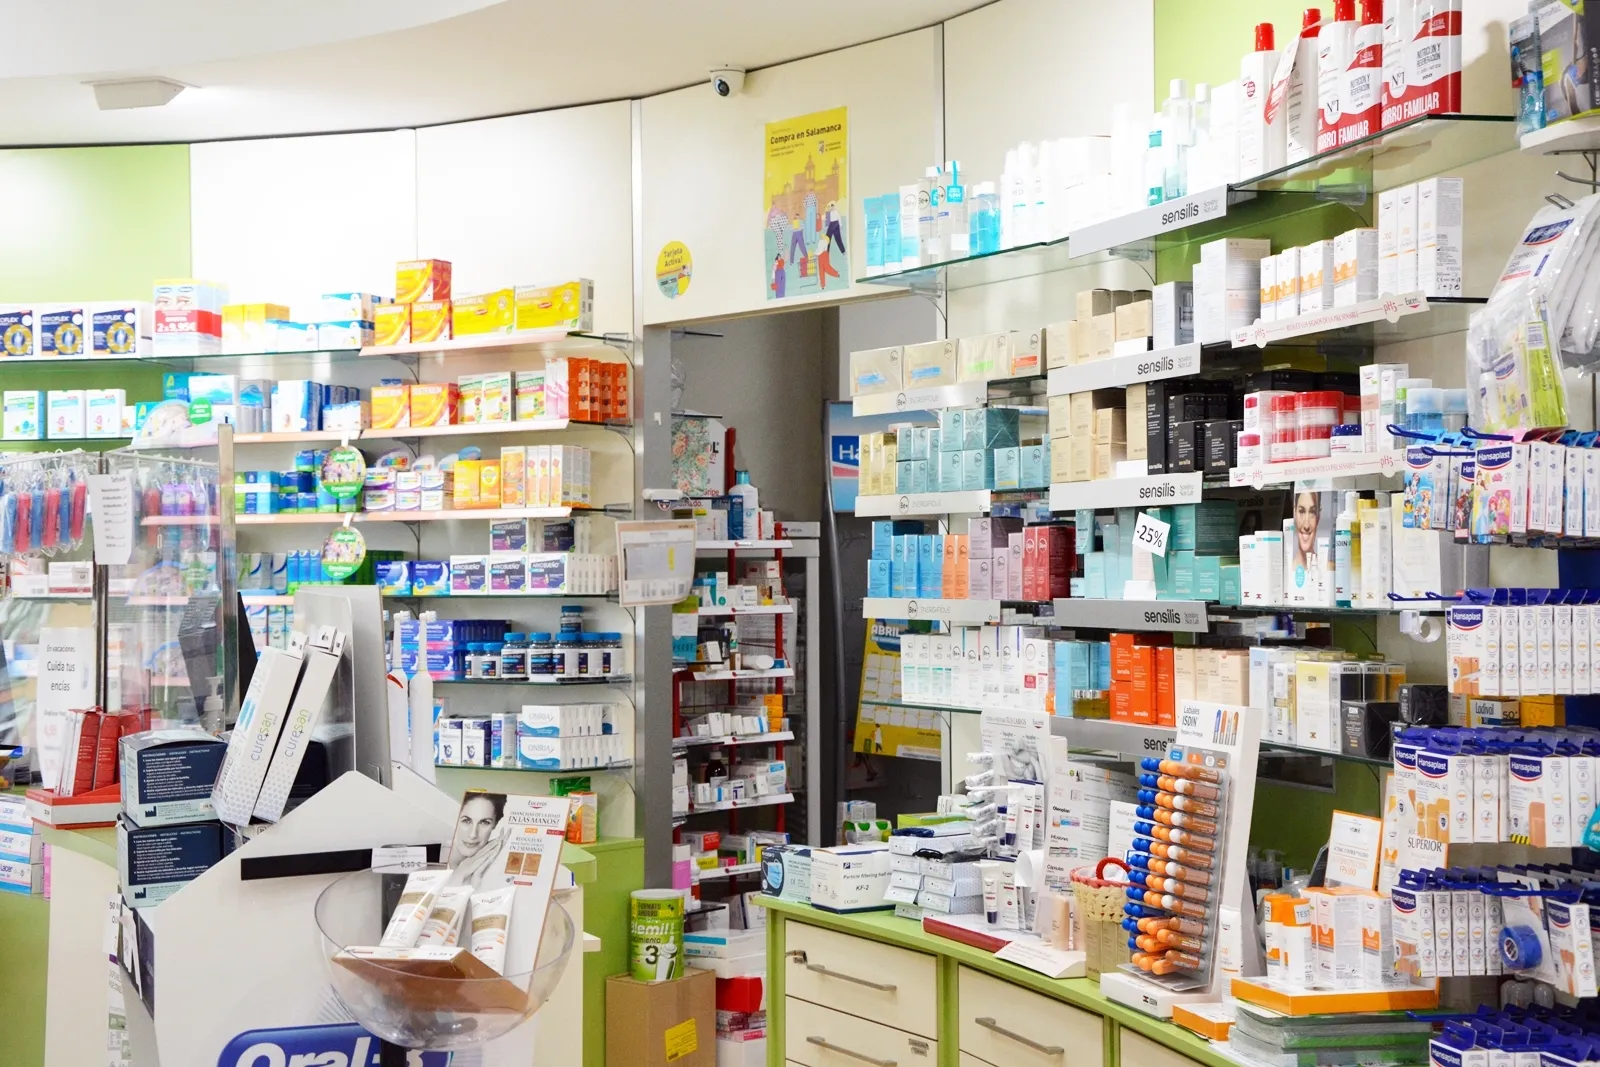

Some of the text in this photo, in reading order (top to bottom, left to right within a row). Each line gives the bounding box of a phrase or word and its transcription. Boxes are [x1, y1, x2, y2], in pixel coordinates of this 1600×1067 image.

[1404, 92, 1440, 120] FAMILIAR
[770, 124, 842, 144] Compra en Salamanca
[1338, 120, 1369, 144] FAMILIAR
[1162, 202, 1199, 226] sensilis
[664, 247, 683, 258] Tarjeta
[664, 258, 683, 268] Activa!
[1383, 301, 1397, 315] pH5
[1254, 328, 1265, 340] pH5
[1137, 356, 1174, 375] sensilis
[1380, 456, 1393, 468] pH5
[1478, 451, 1510, 462] Hansaplast
[1139, 483, 1175, 499] sensilis
[1136, 525, 1163, 548] -25%
[1144, 609, 1181, 624] sensilis
[1453, 612, 1481, 622] Hansaplast
[871, 624, 900, 636] ABRIL
[47, 661, 75, 672] Cuida tus
[50, 680, 70, 692] encías
[1184, 705, 1200, 715] Labiales
[1475, 703, 1495, 715] Ladival
[1182, 716, 1197, 727] ISDIN
[1144, 737, 1176, 751] sens
[1396, 750, 1416, 762] Hansap
[1419, 758, 1446, 770] Hansaplast
[1511, 762, 1541, 774] Hansaplast
[1396, 770, 1416, 780] FINGERTI
[1408, 837, 1442, 852] SUPERIOR
[1392, 893, 1415, 906] Hansaplast
[1296, 910, 1310, 918] TEST
[645, 945, 659, 965] 3
[1431, 1052, 1461, 1066] Hansaplast
